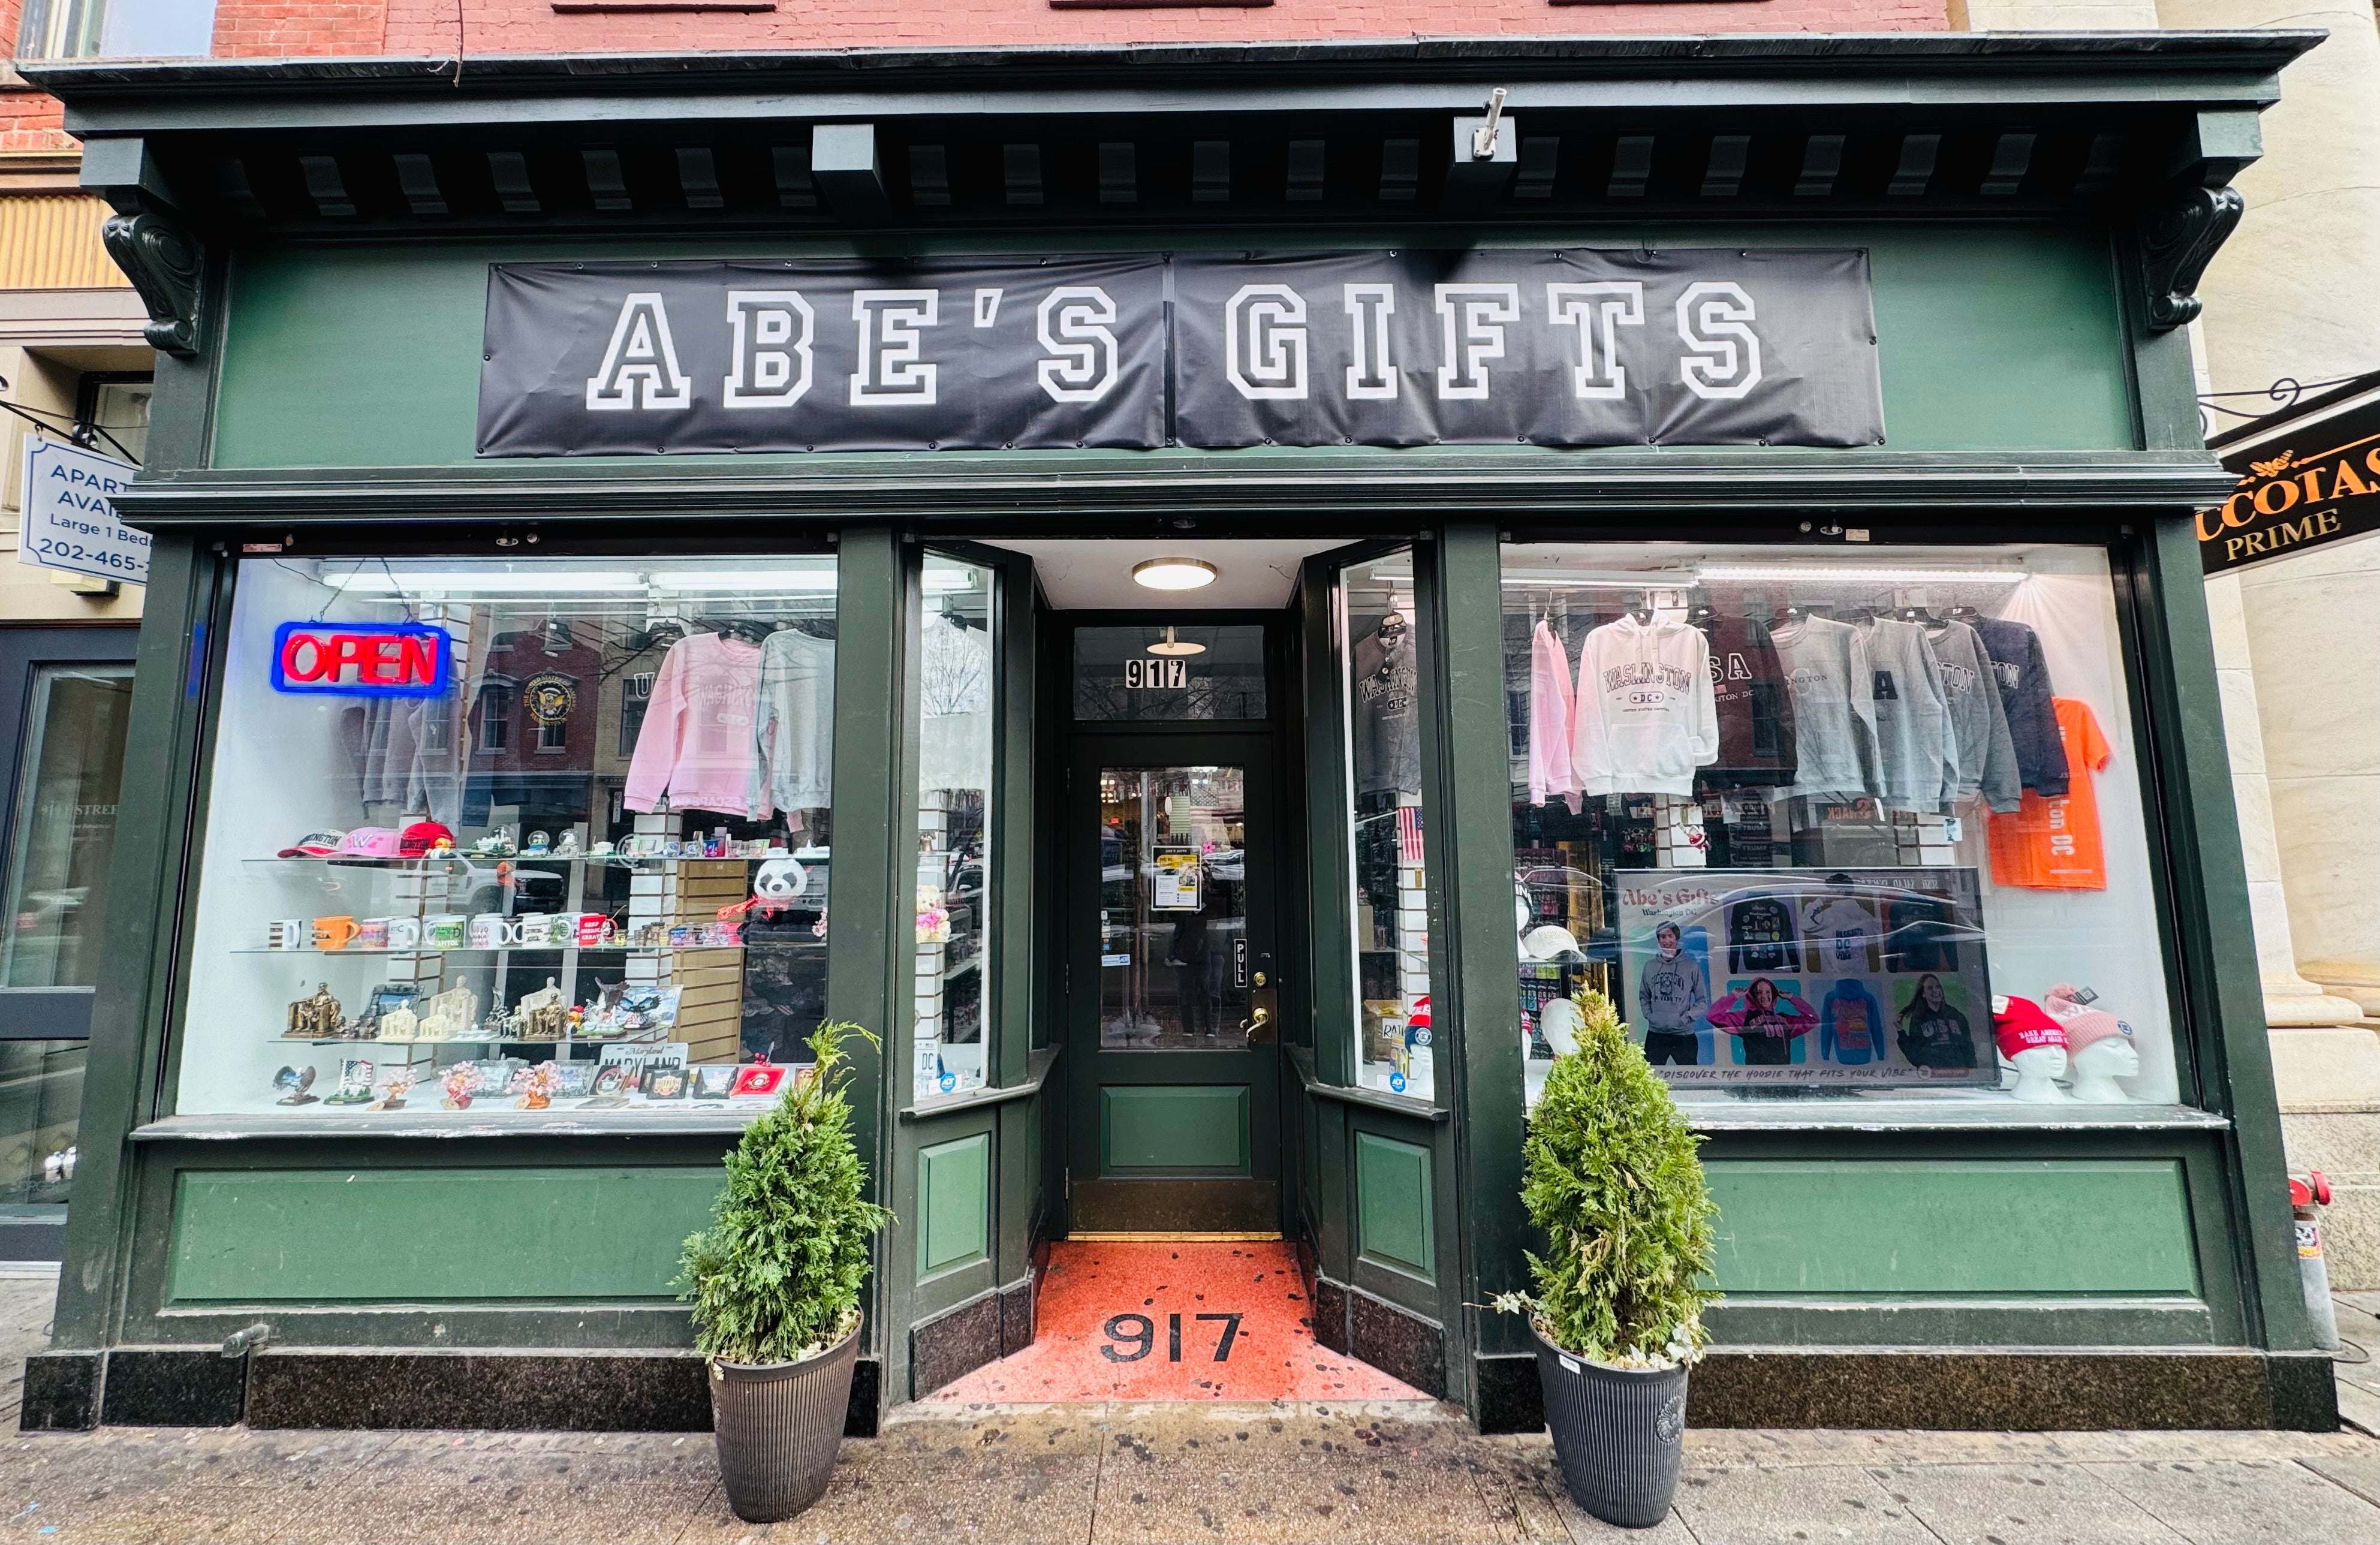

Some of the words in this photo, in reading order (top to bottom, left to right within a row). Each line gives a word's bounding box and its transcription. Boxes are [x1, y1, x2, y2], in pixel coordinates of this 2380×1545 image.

[586, 287, 1118, 409] ABE'S
[1226, 282, 1763, 399] GIFTS
[51, 513, 100, 535] Large
[106, 527, 112, 538] 1
[2224, 508, 2341, 562] PRIME
[281, 634, 438, 685] OPEN
[1128, 660, 1184, 687] 917
[1603, 662, 1691, 695] WASHINGTON
[1872, 670, 1898, 700] A
[1640, 694, 1652, 702] DC
[1622, 889, 1673, 906] Abe's
[1642, 908, 1683, 917] Washington
[625, 1046, 664, 1056] Maryland
[922, 1053, 934, 1070] DC
[1659, 1069, 1718, 1079] "DISCOVER
[1721, 1070, 1741, 1080] THE
[1746, 1070, 1785, 1080] HOODIE
[1789, 1070, 1813, 1080] THAT
[1819, 1070, 1845, 1078] FITS
[1849, 1068, 1877, 1078] YOUR
[1881, 1067, 1912, 1078] VIBE"
[1101, 1313, 1243, 1363] 917
